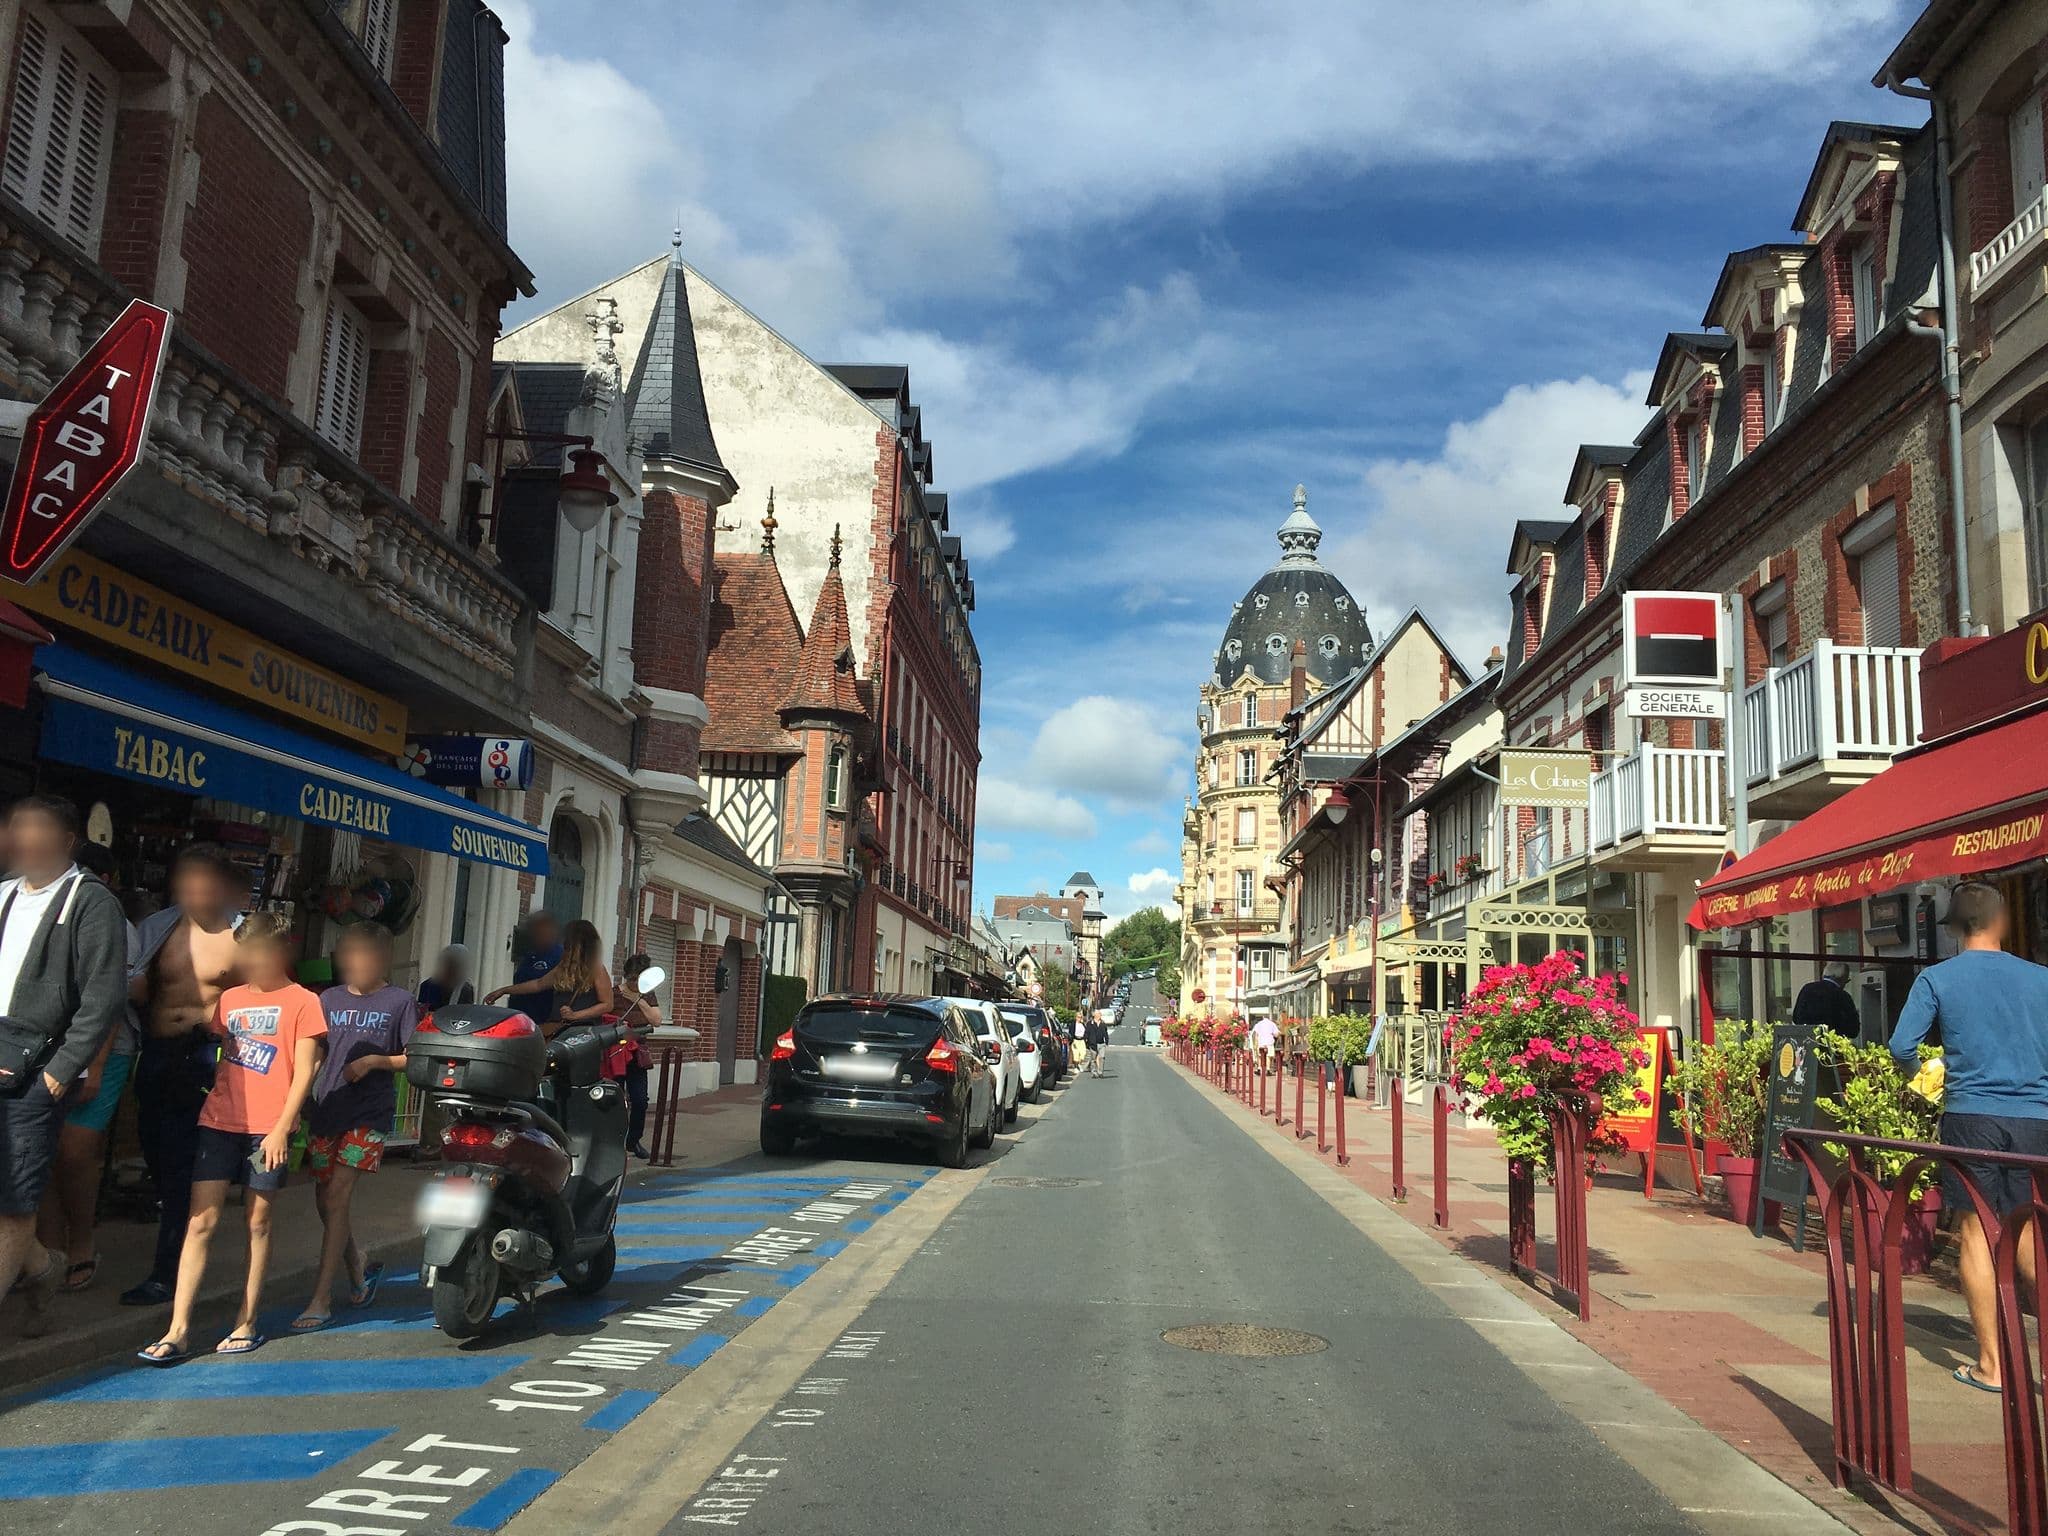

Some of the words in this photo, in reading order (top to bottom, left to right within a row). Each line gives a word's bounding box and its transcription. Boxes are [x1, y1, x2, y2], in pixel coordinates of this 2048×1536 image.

[31, 364, 131, 519] TABAC
[57, 563, 214, 667] CADEAUX
[249, 650, 380, 735] SOUVENIRS
[1640, 693, 1701, 703] SOCIETE
[1640, 703, 1715, 714] GENERALE
[115, 727, 206, 788] TABAC
[300, 783, 391, 835] CADEAUX
[451, 825, 529, 867] SOUVENIRS
[1503, 765, 1527, 785] Les
[1530, 765, 1588, 790] Cabines
[1789, 876, 1806, 899] Le
[1812, 867, 1852, 902] Jardin
[1858, 859, 1874, 884] du
[1952, 815, 2044, 857] RESTAURATION
[330, 1010, 391, 1030] NATURE
[721, 1227, 820, 1265] ARRET
[488, 1380, 607, 1412] 10
[552, 1337, 672, 1370] MN
[620, 1285, 750, 1330] MAXI
[682, 1453, 787, 1525] ARRET
[770, 1409, 825, 1428] 10
[825, 1331, 886, 1358] MAXI
